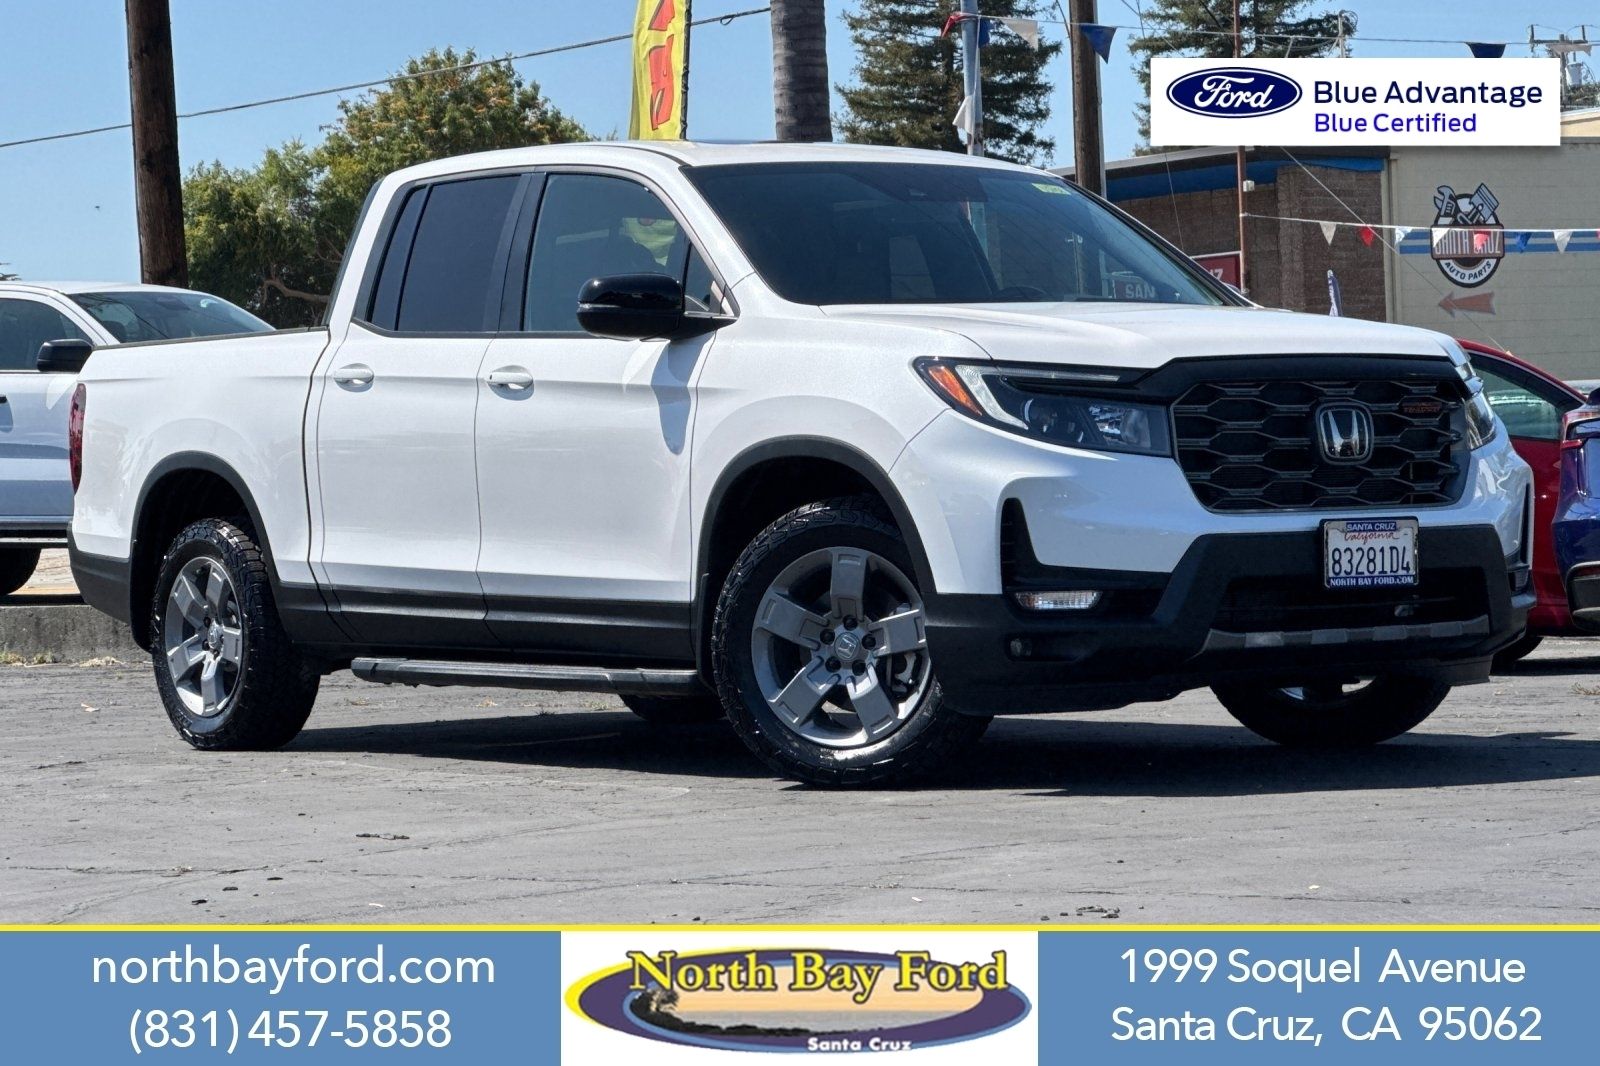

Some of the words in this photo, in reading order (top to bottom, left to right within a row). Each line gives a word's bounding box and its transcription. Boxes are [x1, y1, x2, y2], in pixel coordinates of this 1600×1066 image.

[1473, 229, 1501, 254] UZ
[1444, 261, 1466, 280] AUTO
[1468, 261, 1492, 280] PARTS
[1347, 522, 1373, 531] SANTA
[1374, 522, 1396, 531] CRUZ
[1344, 532, 1400, 545] California
[1331, 545, 1411, 576] 83281D4
[1330, 577, 1356, 586] NORTH
[1358, 577, 1372, 585] BAY
[1374, 575, 1414, 585] FORD.COM
